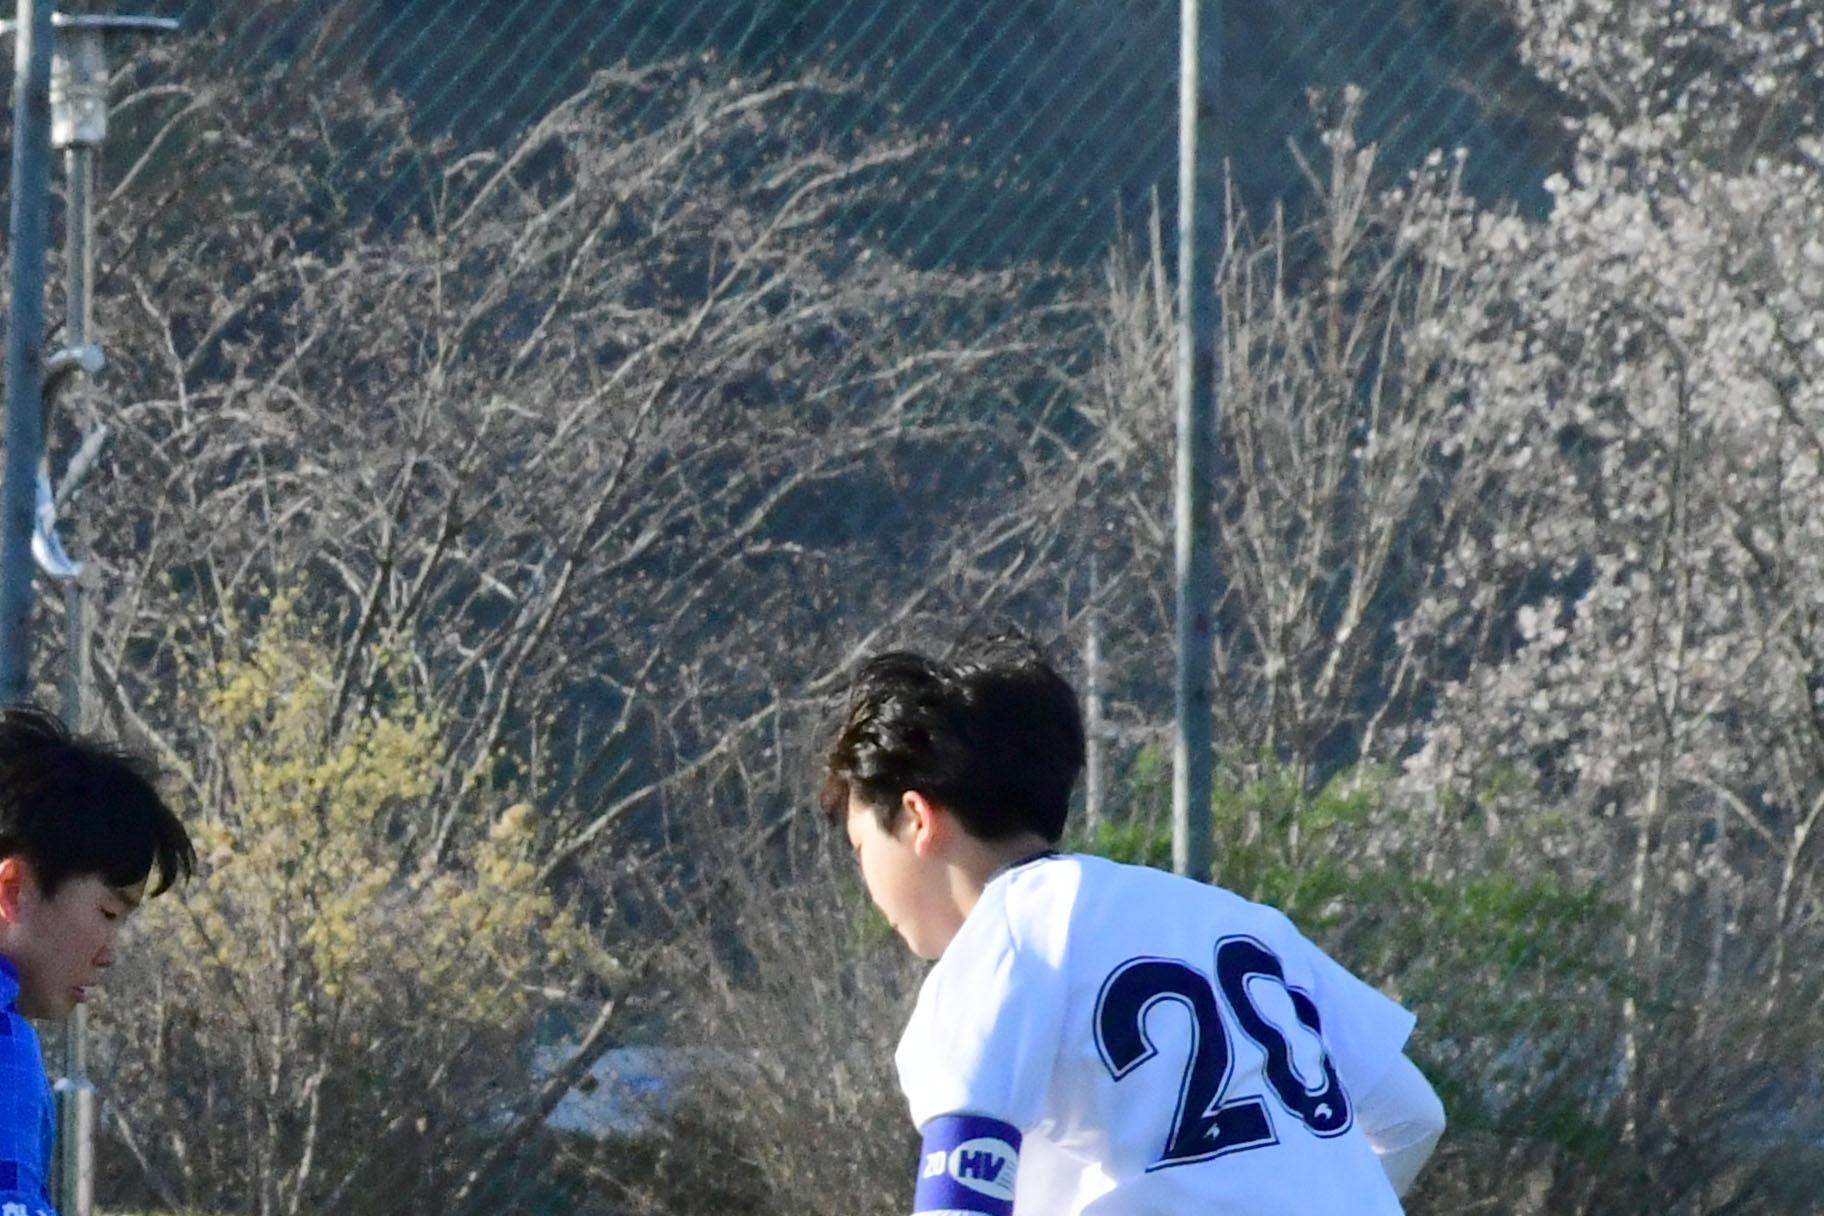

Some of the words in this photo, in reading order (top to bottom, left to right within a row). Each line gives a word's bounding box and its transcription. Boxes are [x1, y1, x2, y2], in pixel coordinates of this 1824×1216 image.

[1092, 933, 1354, 1174] 20
[923, 1150, 946, 1179] 20
[958, 1149, 1006, 1182] HV
